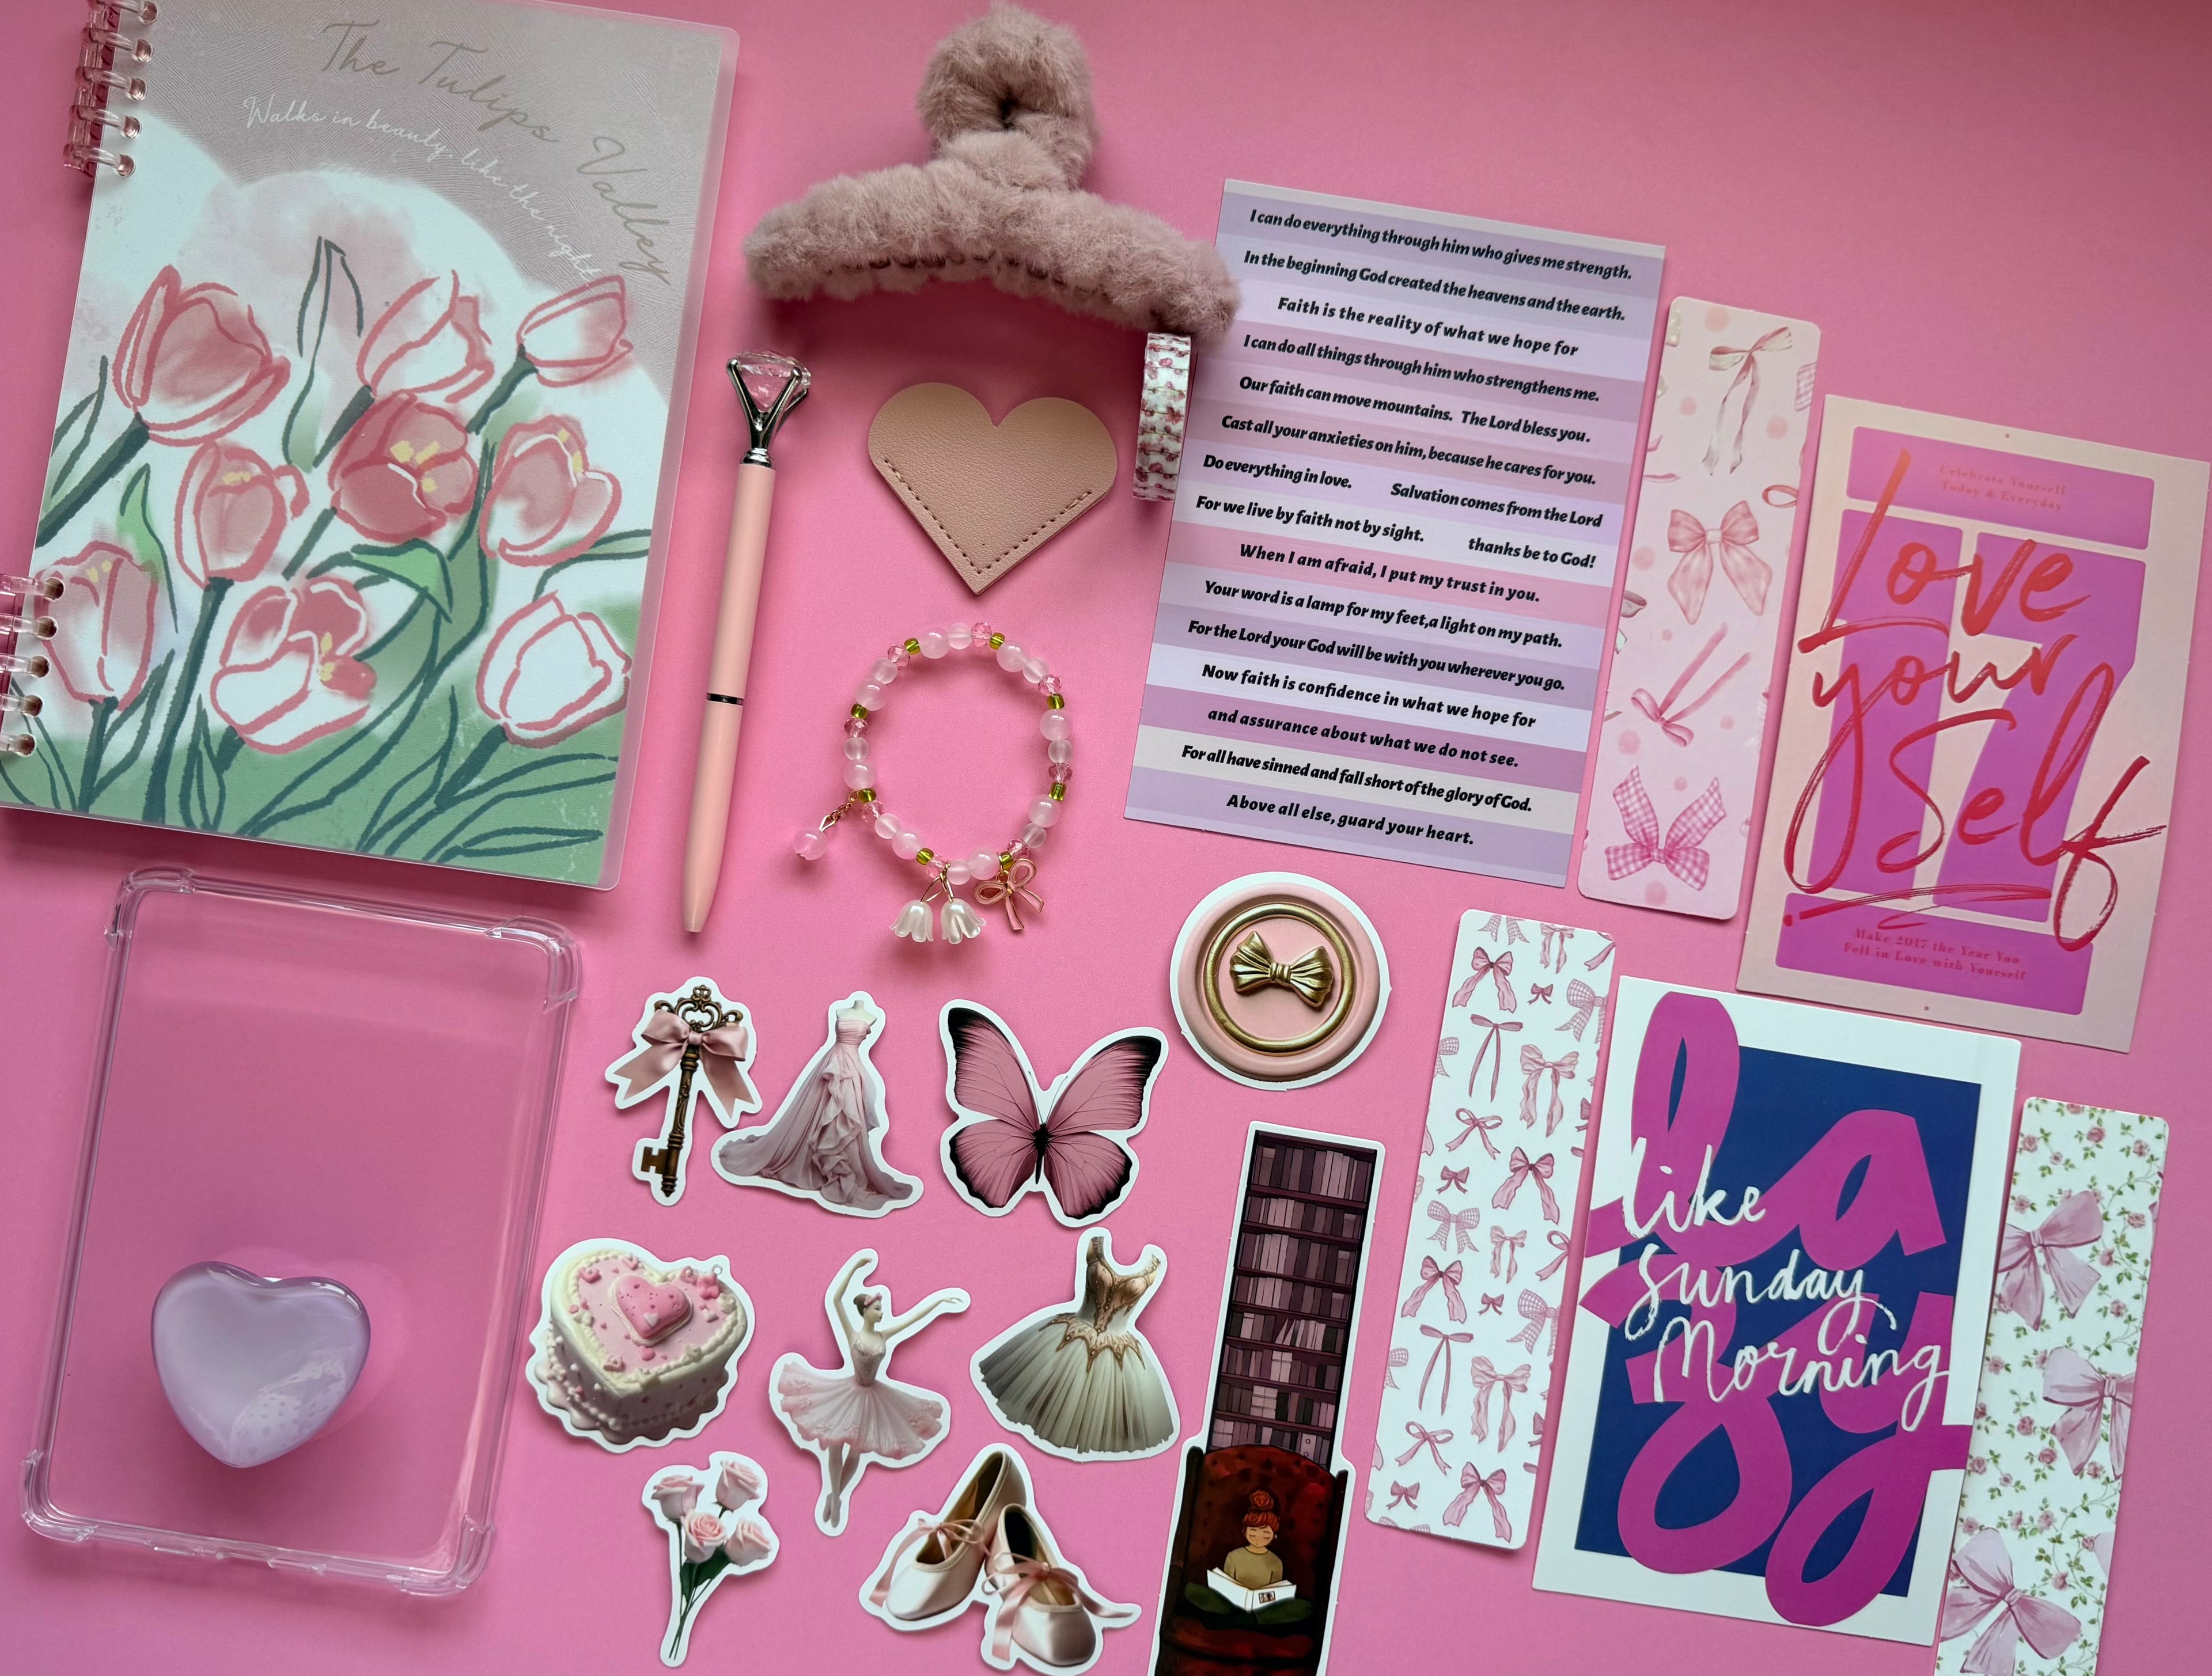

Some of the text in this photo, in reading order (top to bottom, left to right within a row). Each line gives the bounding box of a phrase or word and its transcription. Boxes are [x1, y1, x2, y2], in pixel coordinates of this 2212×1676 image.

[244, 94, 327, 128] Walks
[332, 111, 362, 127] in
[461, 147, 509, 188] like
[509, 184, 544, 221] the
[322, 19, 671, 286] The Tulips Valley
[1249, 208, 1633, 280] I can do everything through him who gives me strength.
[1243, 249, 1626, 321] In the beginning God created the heavens and the earth.
[1277, 297, 1580, 357] Faith is the reality of what we hope for
[1243, 333, 1600, 403] I can do all things through him who strengthens me.
[1238, 376, 1591, 443] Our faith can move mountains. The Lord bless you.
[1221, 414, 1596, 486] Cast all your anxieties on him, because he cares for you.
[1940, 465, 2067, 496] Celebrate Yourself
[1195, 494, 1425, 543] For we live by faith not by sight.
[1389, 482, 1604, 528] Salvation comes from the Lord
[1940, 479, 1979, 498] Today
[2001, 490, 2063, 511] Everyday
[1240, 543, 1540, 602] When I am afraid, I put my trust in you.
[1797, 448, 2092, 655] Love
[1187, 619, 1565, 692] For the Lord your God will be with you wherever you go.
[1201, 663, 1537, 728] Now faith is confidence in what we hope for
[1207, 709, 1519, 768] and assurance about what we do not see.
[1784, 633, 2078, 894] your
[1225, 794, 1474, 845] Above all else, guard your heart.
[1843, 942, 2027, 980] Fell in Love with Yourself
[1854, 928, 2020, 965] Make 2017 the Year You
[1653, 1315, 1950, 1432] Morning
